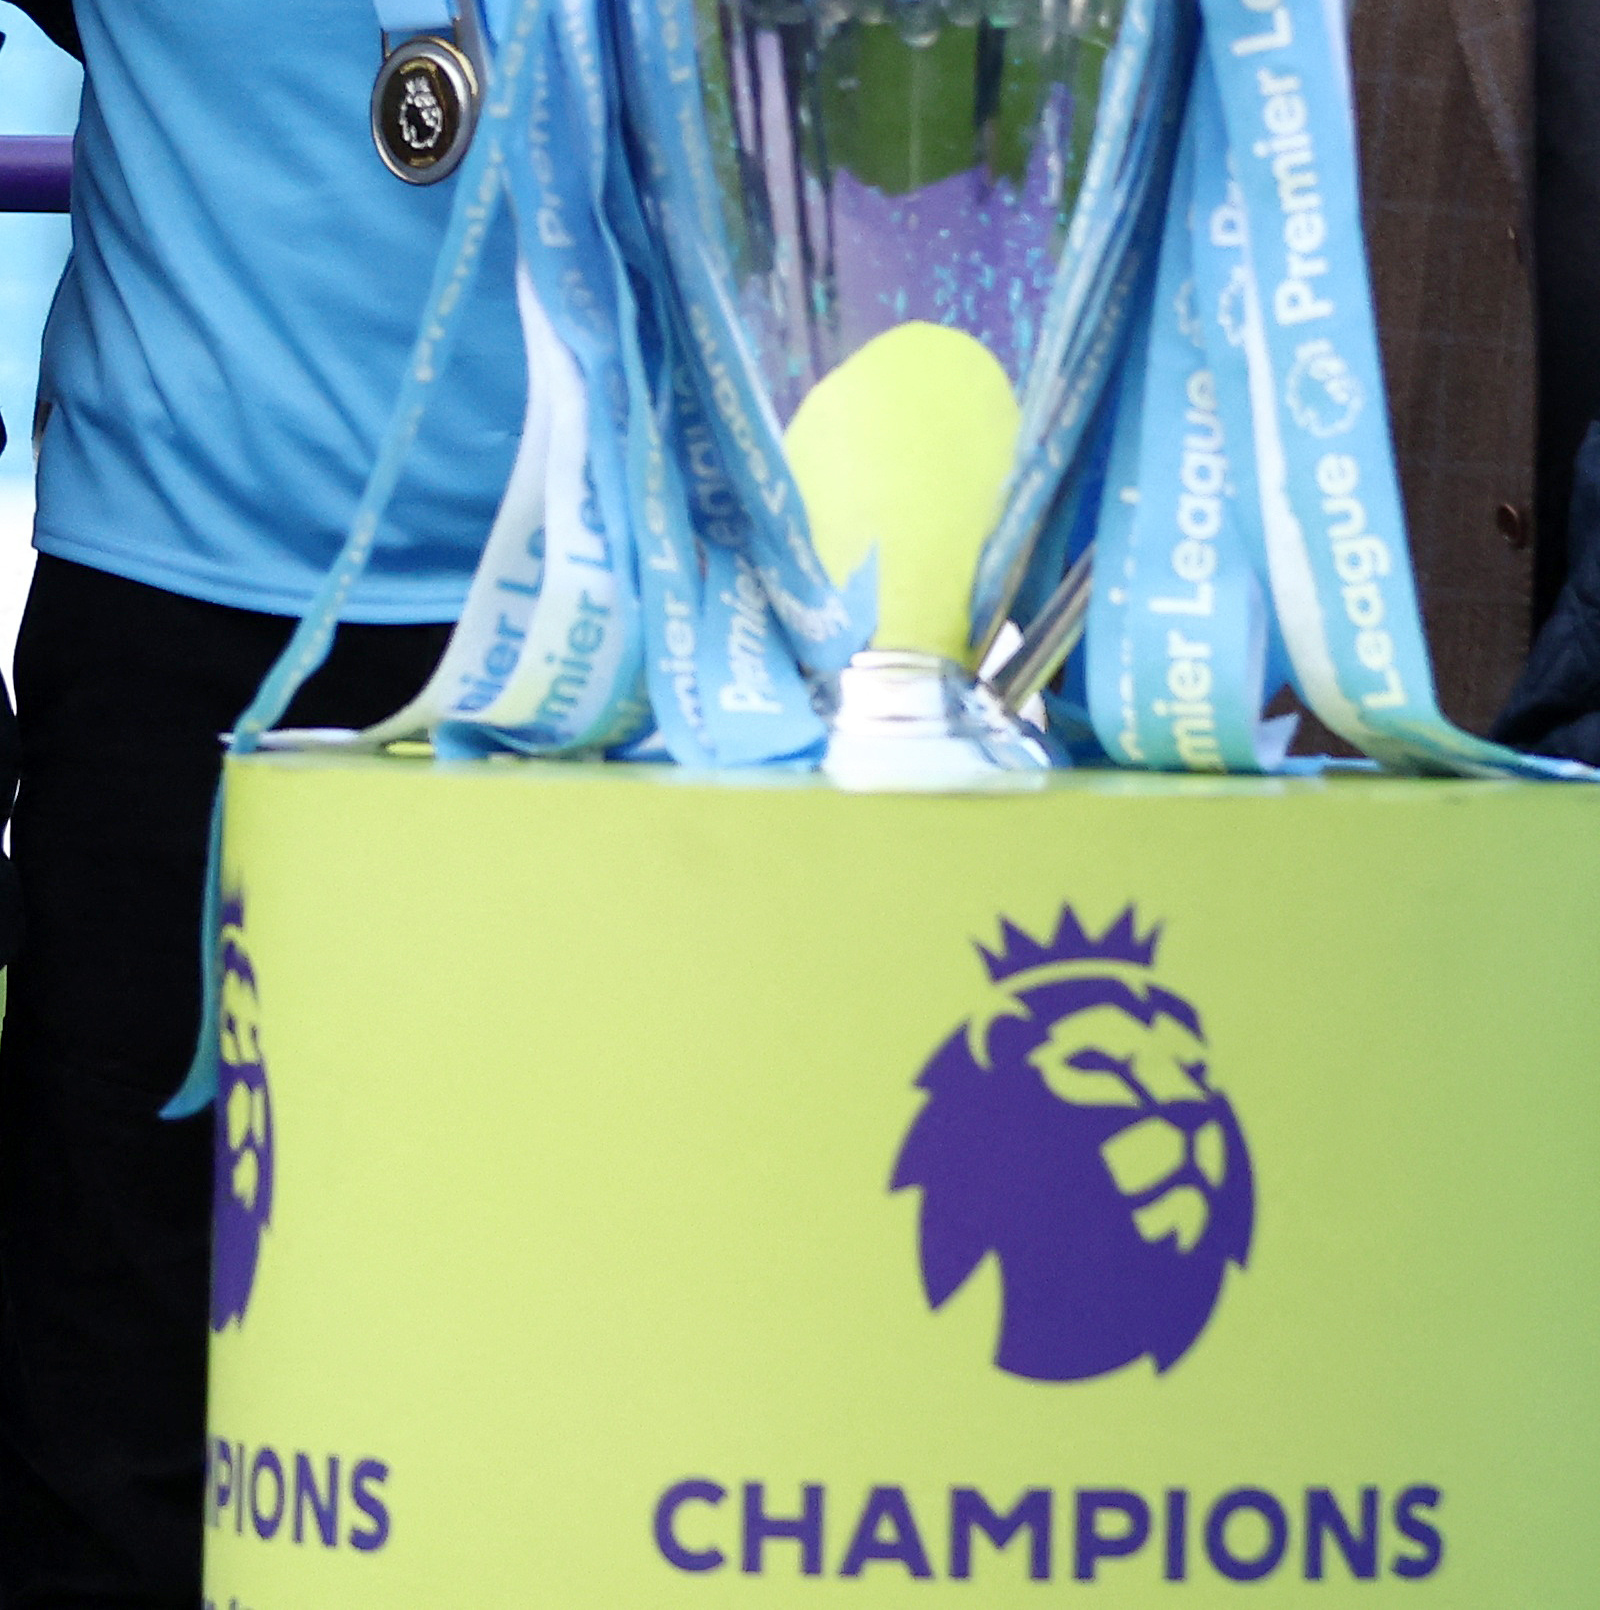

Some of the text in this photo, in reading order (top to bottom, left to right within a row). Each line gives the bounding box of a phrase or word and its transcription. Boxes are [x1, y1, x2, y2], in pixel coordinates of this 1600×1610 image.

[1253, 66, 1335, 326] Premier
[535, 589, 609, 724] mier
[1147, 369, 1232, 774] mier League
[1315, 451, 1408, 710] League
[205, 1435, 390, 1552] PIONS
[652, 1476, 1445, 1584] CHAMPIONS
